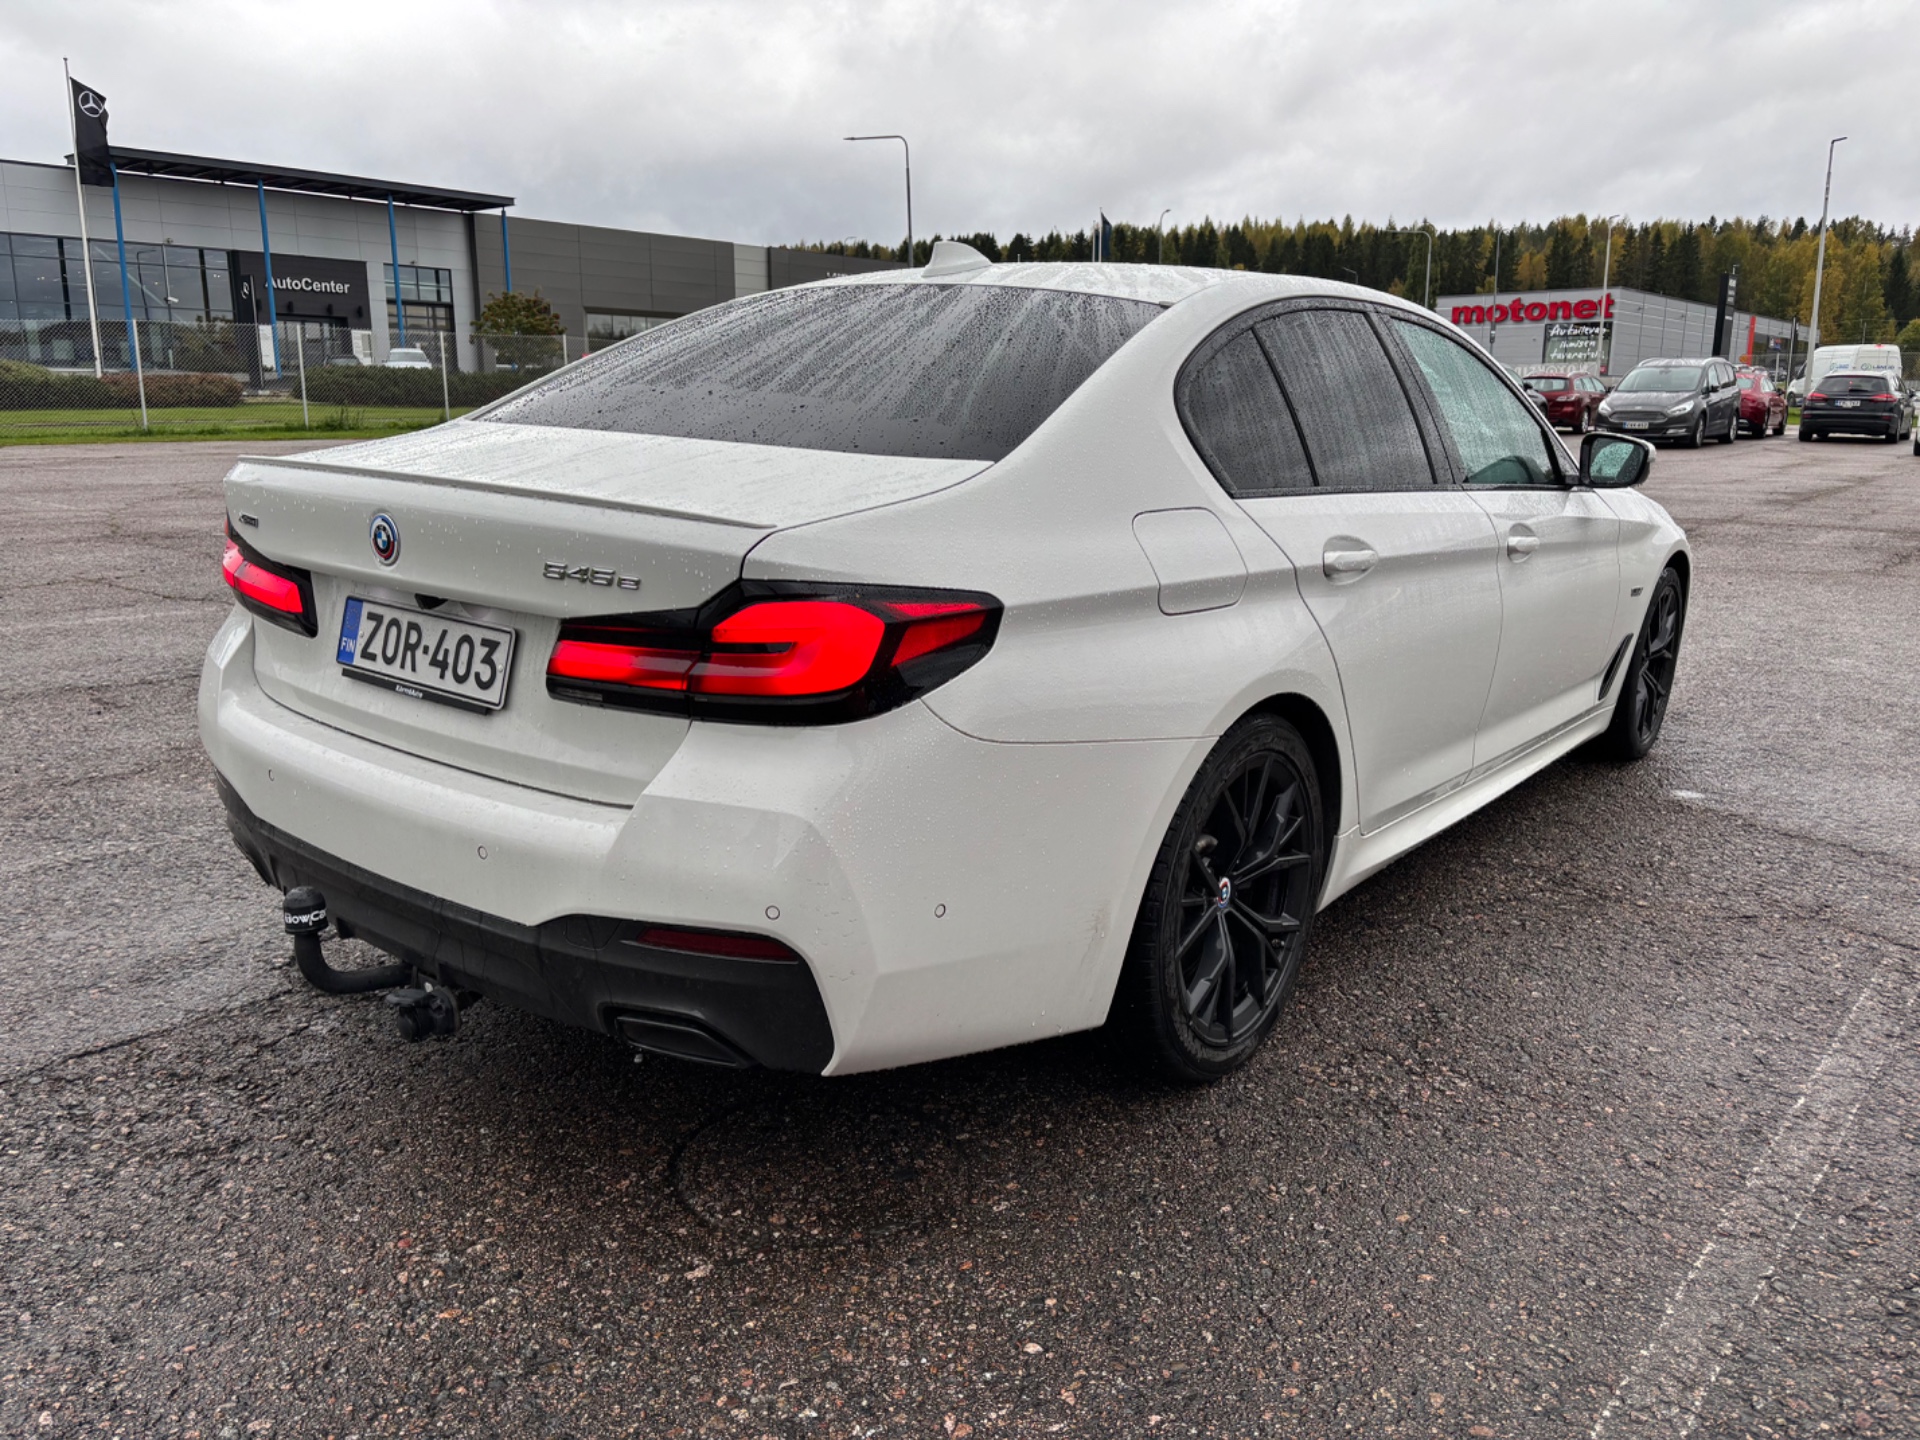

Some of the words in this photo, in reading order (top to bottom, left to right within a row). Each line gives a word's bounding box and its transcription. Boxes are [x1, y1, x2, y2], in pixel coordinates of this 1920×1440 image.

[265, 276, 351, 294] AutoCenter
[1451, 293, 1615, 325] motonet
[341, 637, 356, 654] FIN
[360, 611, 501, 691] ZOR-403
